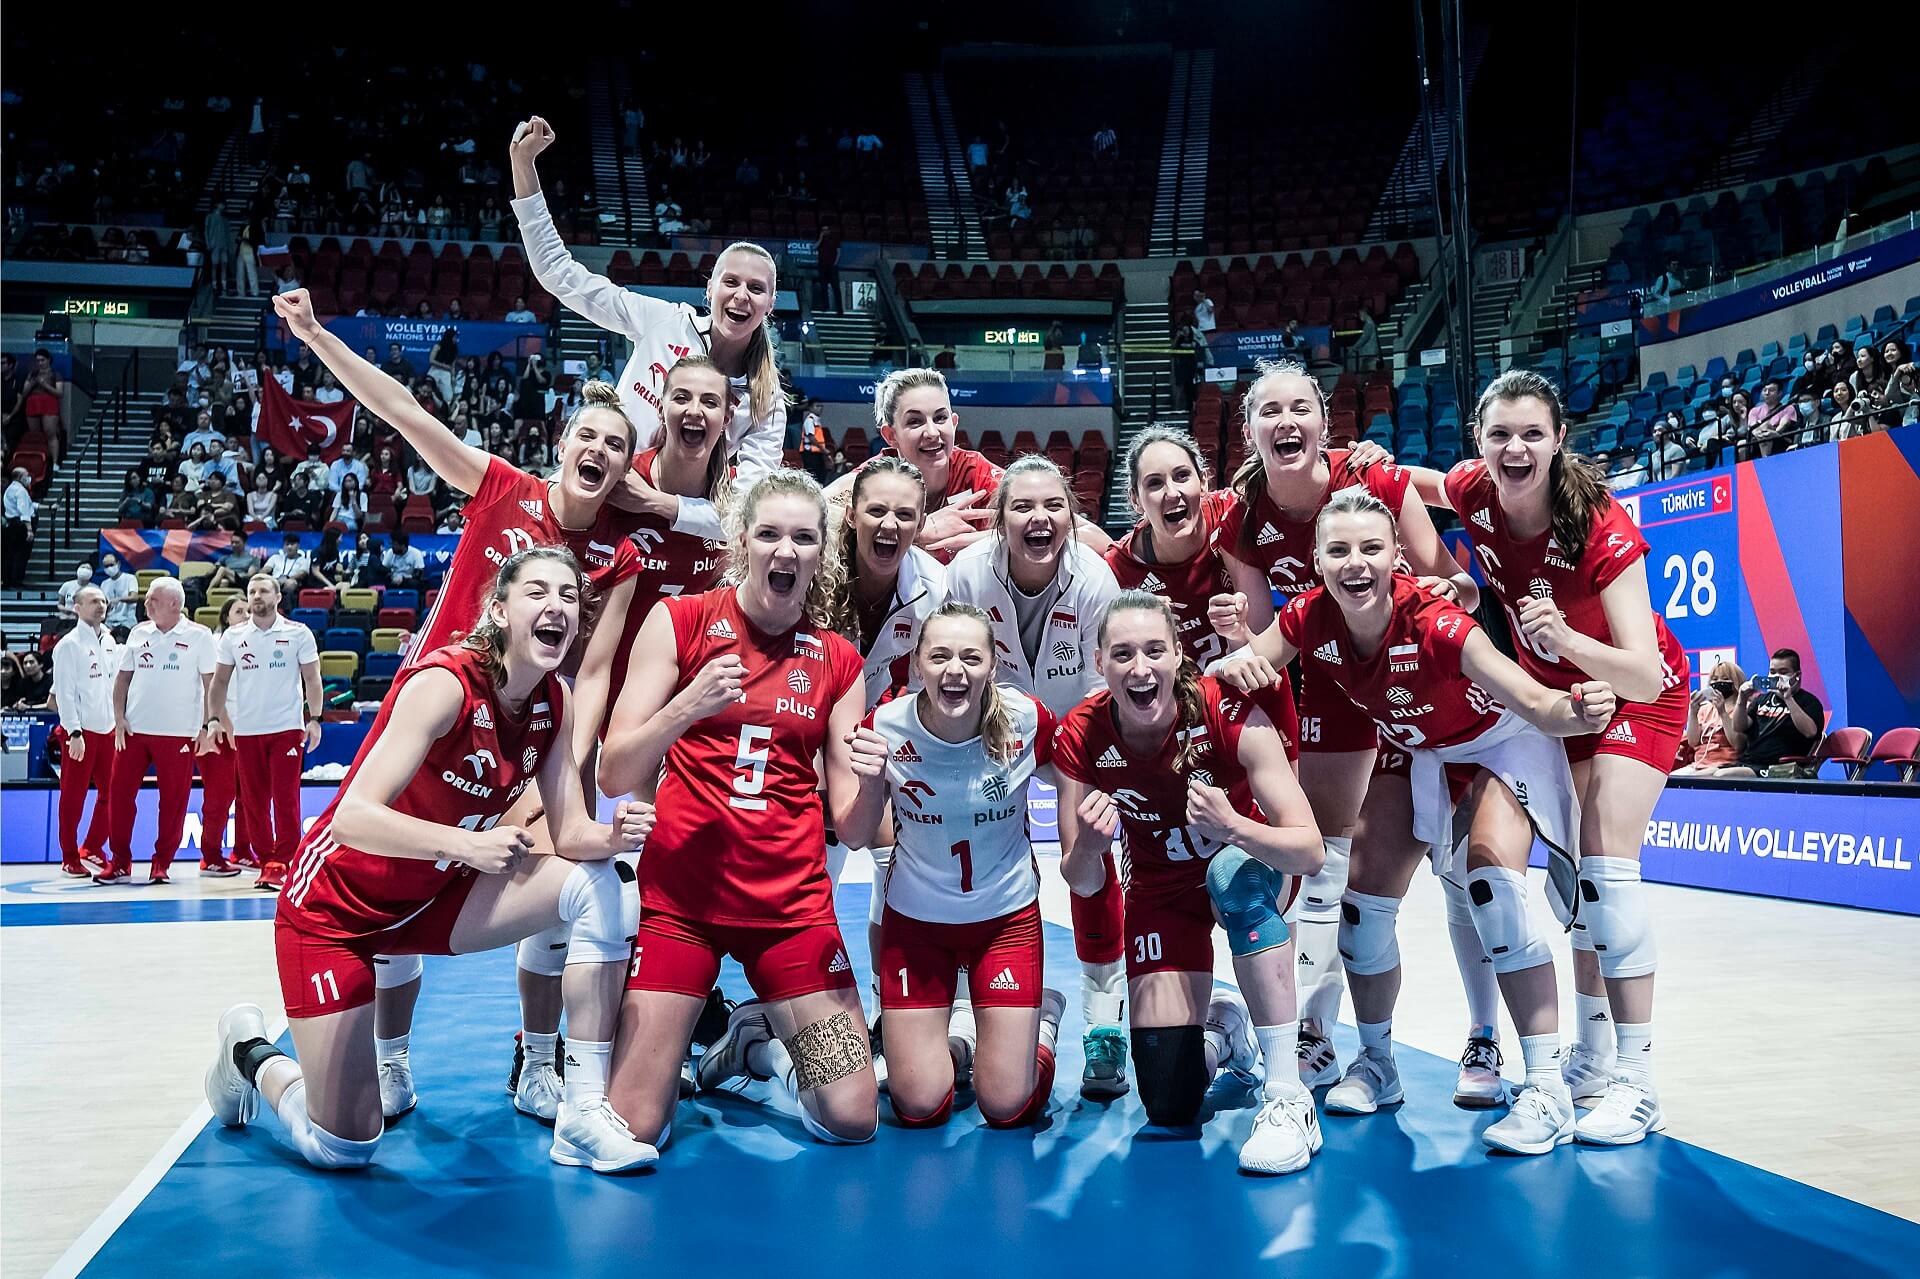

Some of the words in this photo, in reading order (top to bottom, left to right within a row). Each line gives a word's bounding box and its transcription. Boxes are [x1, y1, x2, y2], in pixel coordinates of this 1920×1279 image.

[858, 284, 873, 297] 47
[1772, 272, 1826, 300] VOLLEYBALL
[65, 299, 100, 314] EXIT
[103, 301, 129, 315] 出口
[385, 333, 424, 341] NATIONS
[1661, 489, 1706, 514] TÜRKİYE
[518, 500, 544, 521] adidas
[1470, 515, 1495, 534] adidas
[1256, 534, 1285, 546] adidas
[585, 554, 615, 568] POLSKA
[1663, 549, 1717, 619] 28
[707, 629, 737, 640] adidas
[794, 647, 824, 662] POLSKA
[1313, 650, 1343, 666] adidas
[269, 661, 286, 670] plus
[1047, 660, 1085, 680] plus
[1390, 663, 1419, 673] POLSKA
[776, 697, 816, 720] plus
[1390, 703, 1434, 720] plus
[1605, 732, 1637, 744] adidas
[733, 723, 772, 795] 5
[893, 755, 923, 763] adidas
[1095, 759, 1128, 768] adidas
[1380, 753, 1404, 769] 12
[442, 770, 493, 799] ORLEN
[974, 805, 1017, 827] plus
[1643, 820, 1731, 854] REMIUM
[1736, 826, 1912, 871] VOLLEYBALL
[951, 840, 974, 893] 1
[1134, 932, 1163, 964] 30
[311, 969, 341, 1005] 11
[899, 967, 909, 997] 1
[989, 982, 1020, 991] adidas
